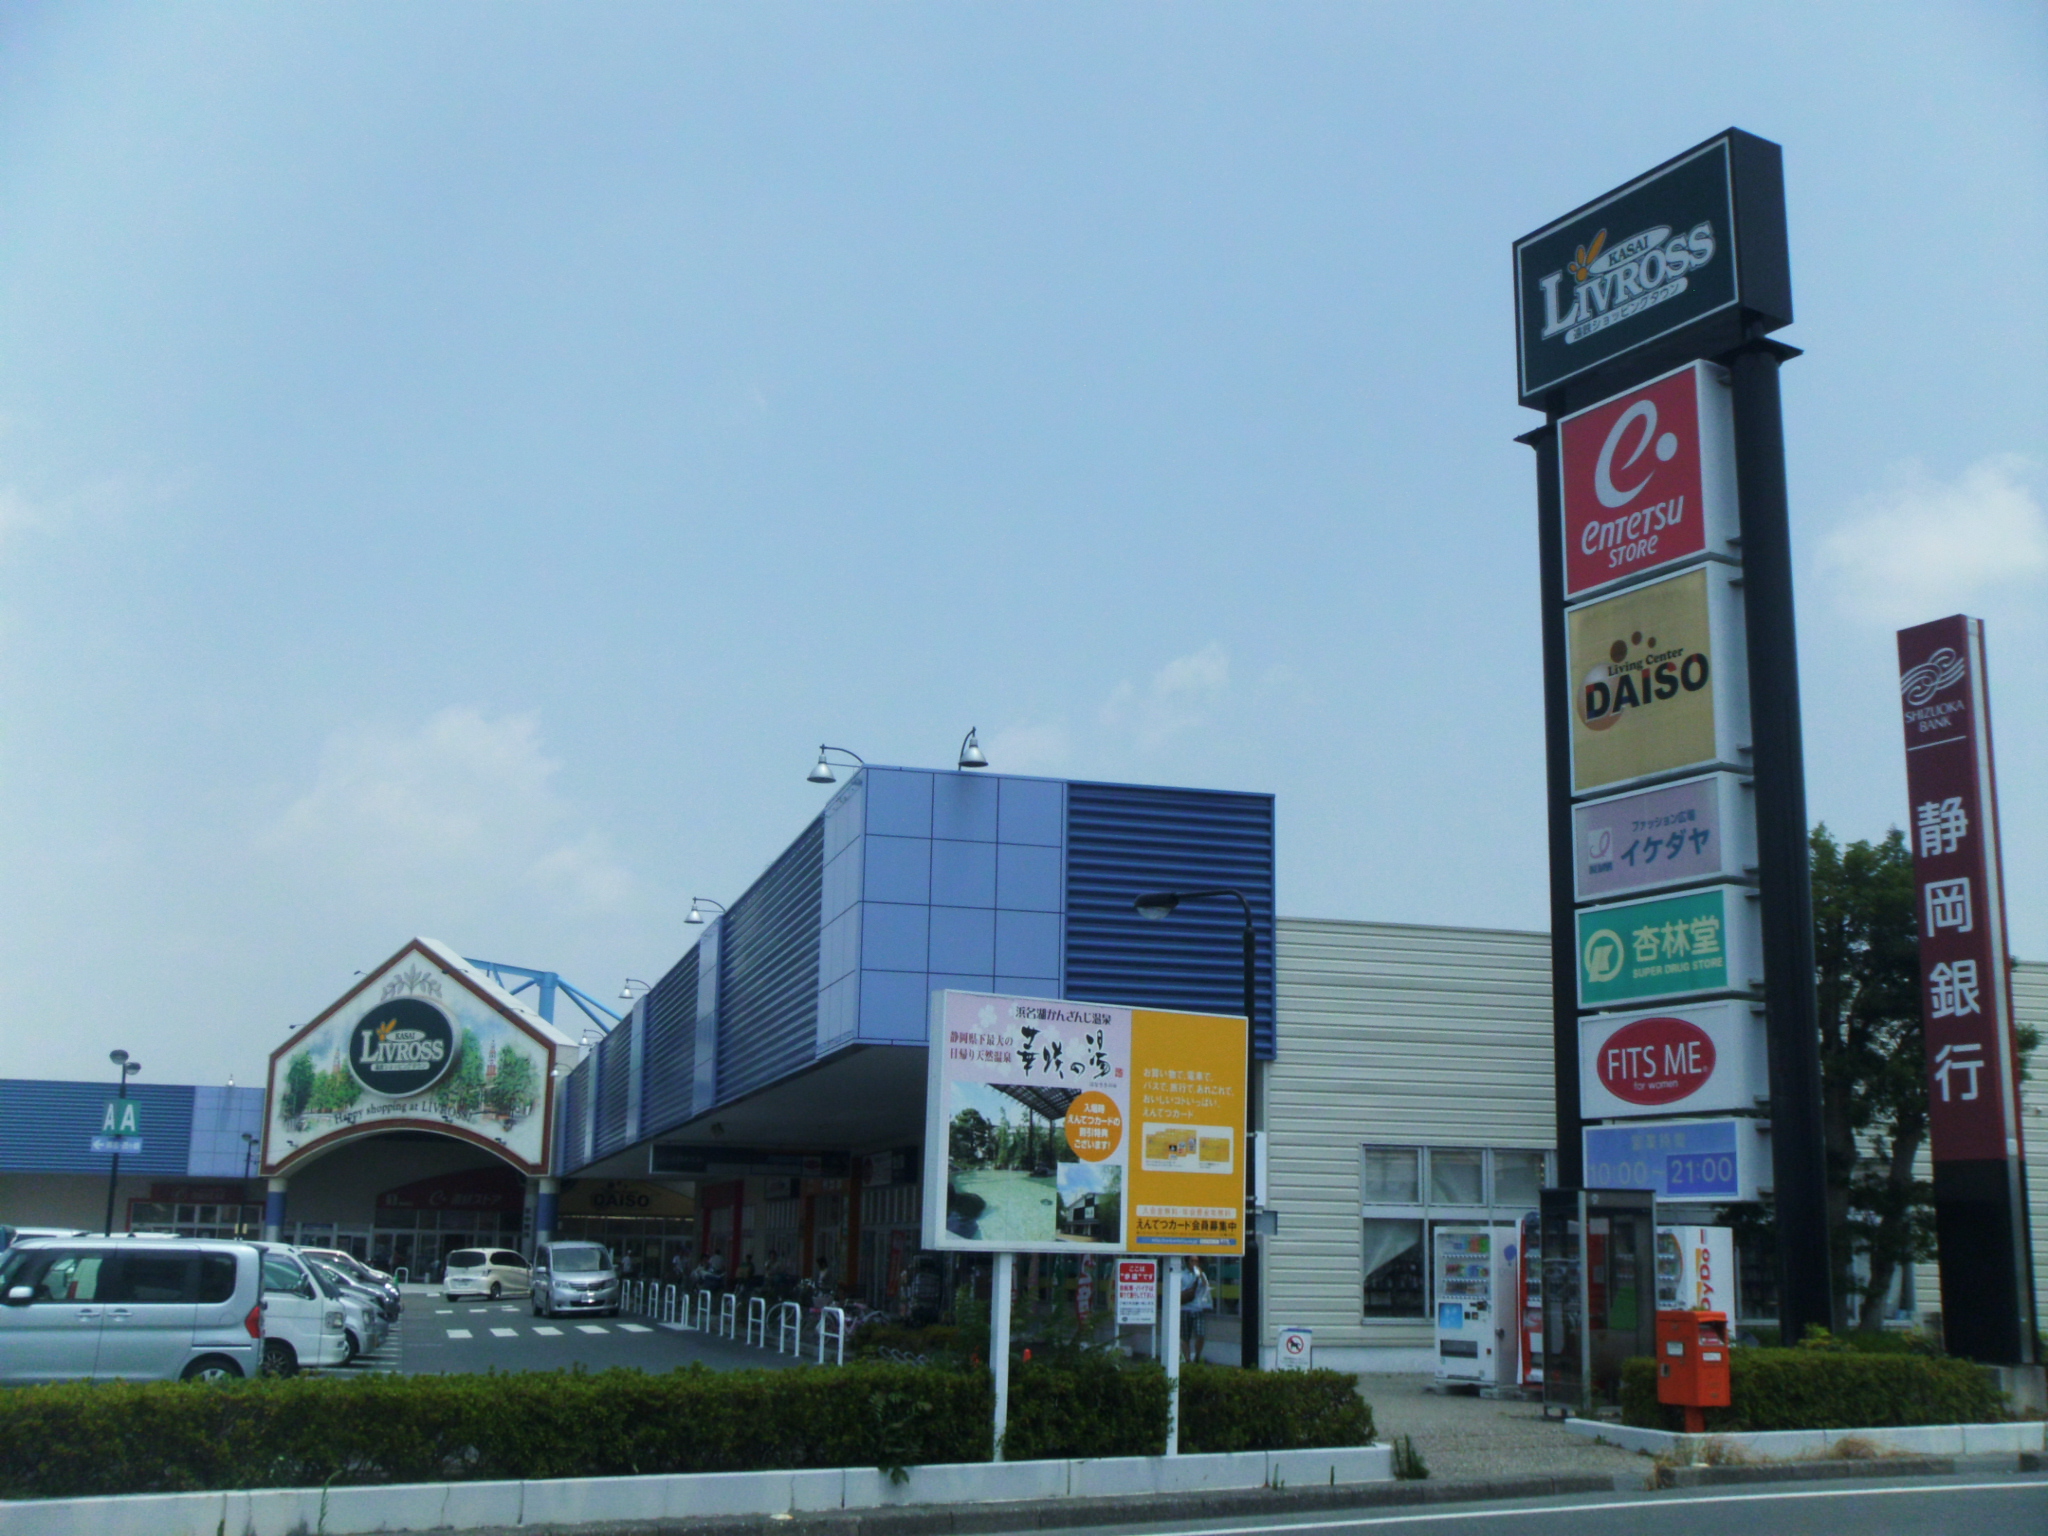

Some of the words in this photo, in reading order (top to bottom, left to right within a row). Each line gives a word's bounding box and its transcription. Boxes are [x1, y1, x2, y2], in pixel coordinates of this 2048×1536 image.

[1609, 235, 1649, 267] KASAI
[1539, 220, 1716, 340] LIVROSS
[1607, 659, 1643, 677] Living
[1645, 648, 1684, 665] Center
[1585, 653, 1709, 720] DAISO
[1904, 700, 1965, 724] SHIZUOKA
[1919, 715, 1951, 733] BANK
[1620, 827, 1710, 867] イケダヤ
[1632, 915, 1720, 962] 杏林堂
[1917, 796, 1985, 1102] 静岡銀行
[1633, 966, 1663, 978] SUPER
[1665, 962, 1690, 973] DRUG
[1692, 957, 1723, 970] STORE
[359, 1030, 444, 1063] LIVROSS
[950, 1031, 1013, 1047] 静岡県下最大の
[950, 1049, 1012, 1063] 日帰り天然温泉
[1607, 1045, 1657, 1081] FITS
[1664, 1041, 1702, 1076] ME
[1633, 1081, 1645, 1091] for
[1648, 1080, 1679, 1090] women
[103, 1103, 115, 1131] A
[119, 1104, 136, 1132] A
[366, 1100, 407, 1114] shopping
[409, 1102, 418, 1111] at
[593, 1193, 650, 1208] DAISO
